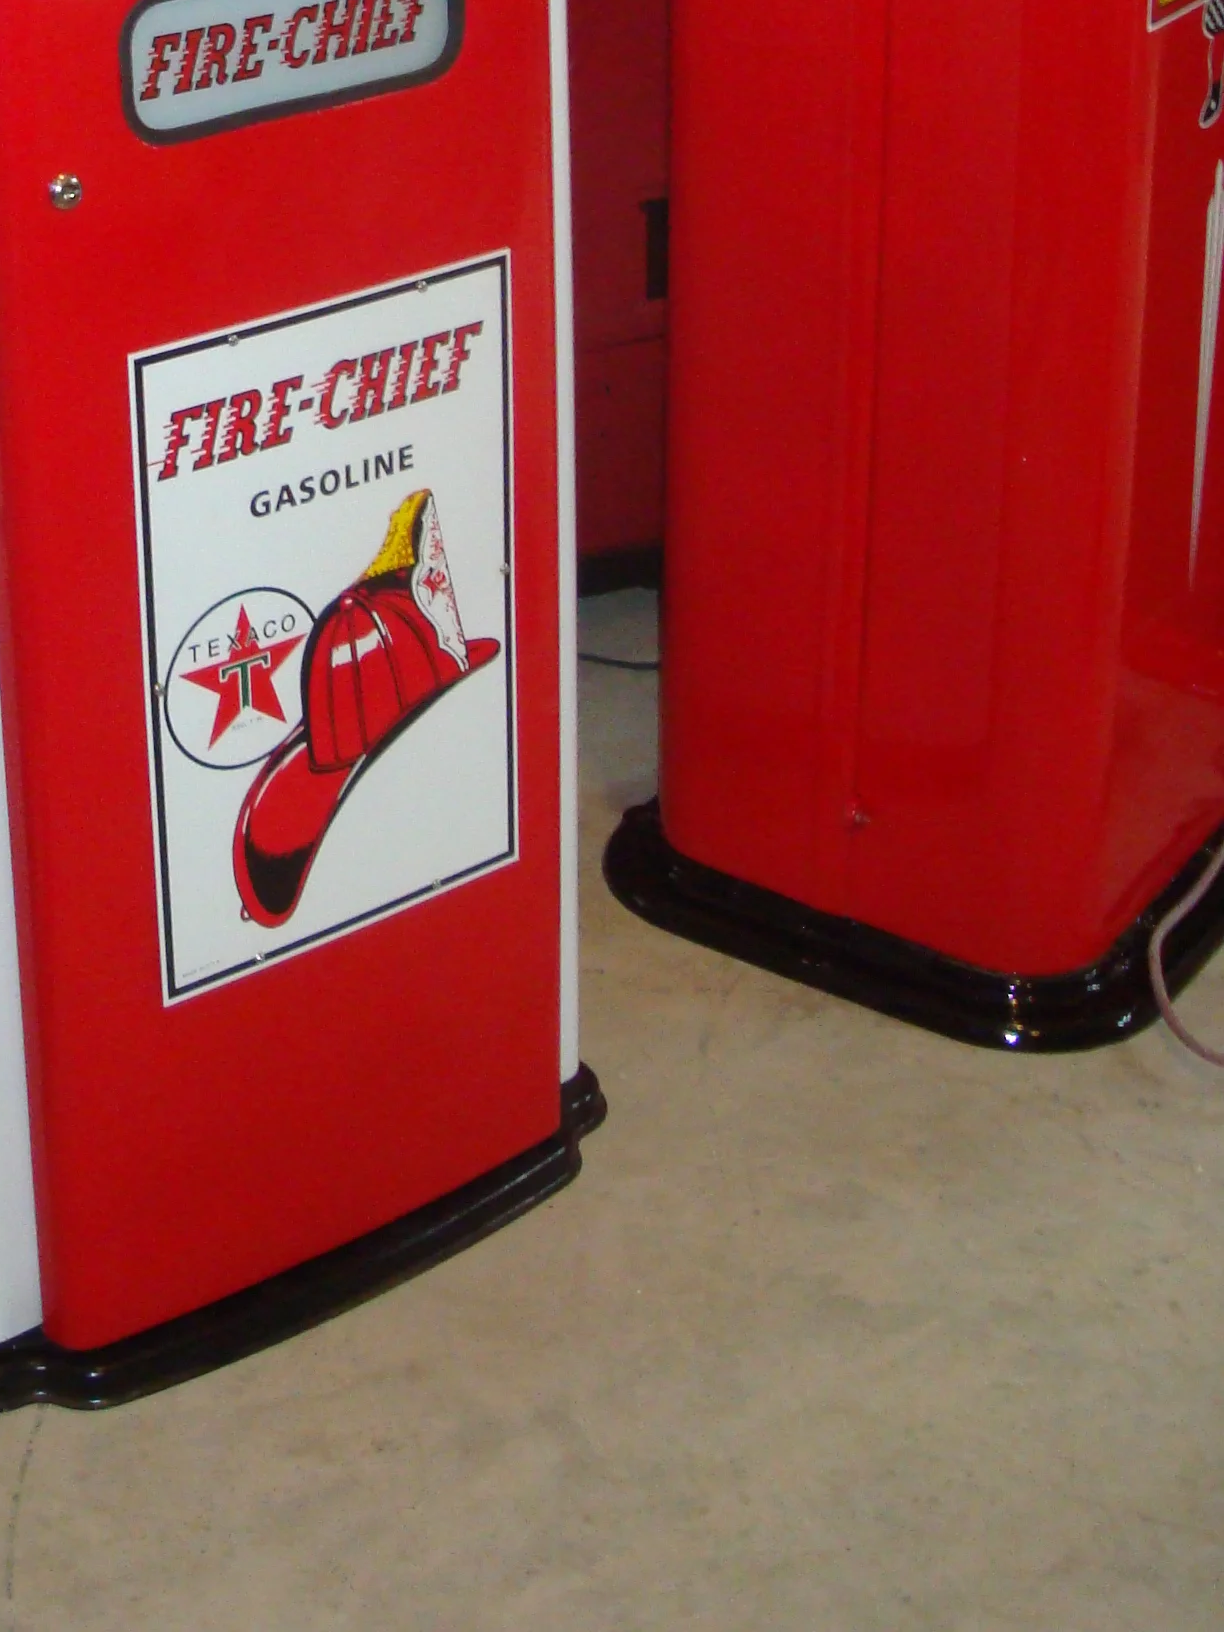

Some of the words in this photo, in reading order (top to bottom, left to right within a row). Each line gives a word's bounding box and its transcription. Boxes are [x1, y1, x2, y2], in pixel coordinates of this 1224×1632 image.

[155, 320, 484, 482] FIRE-CHIEF
[249, 444, 415, 518] GASOLINE
[188, 613, 296, 663] TEXACO
